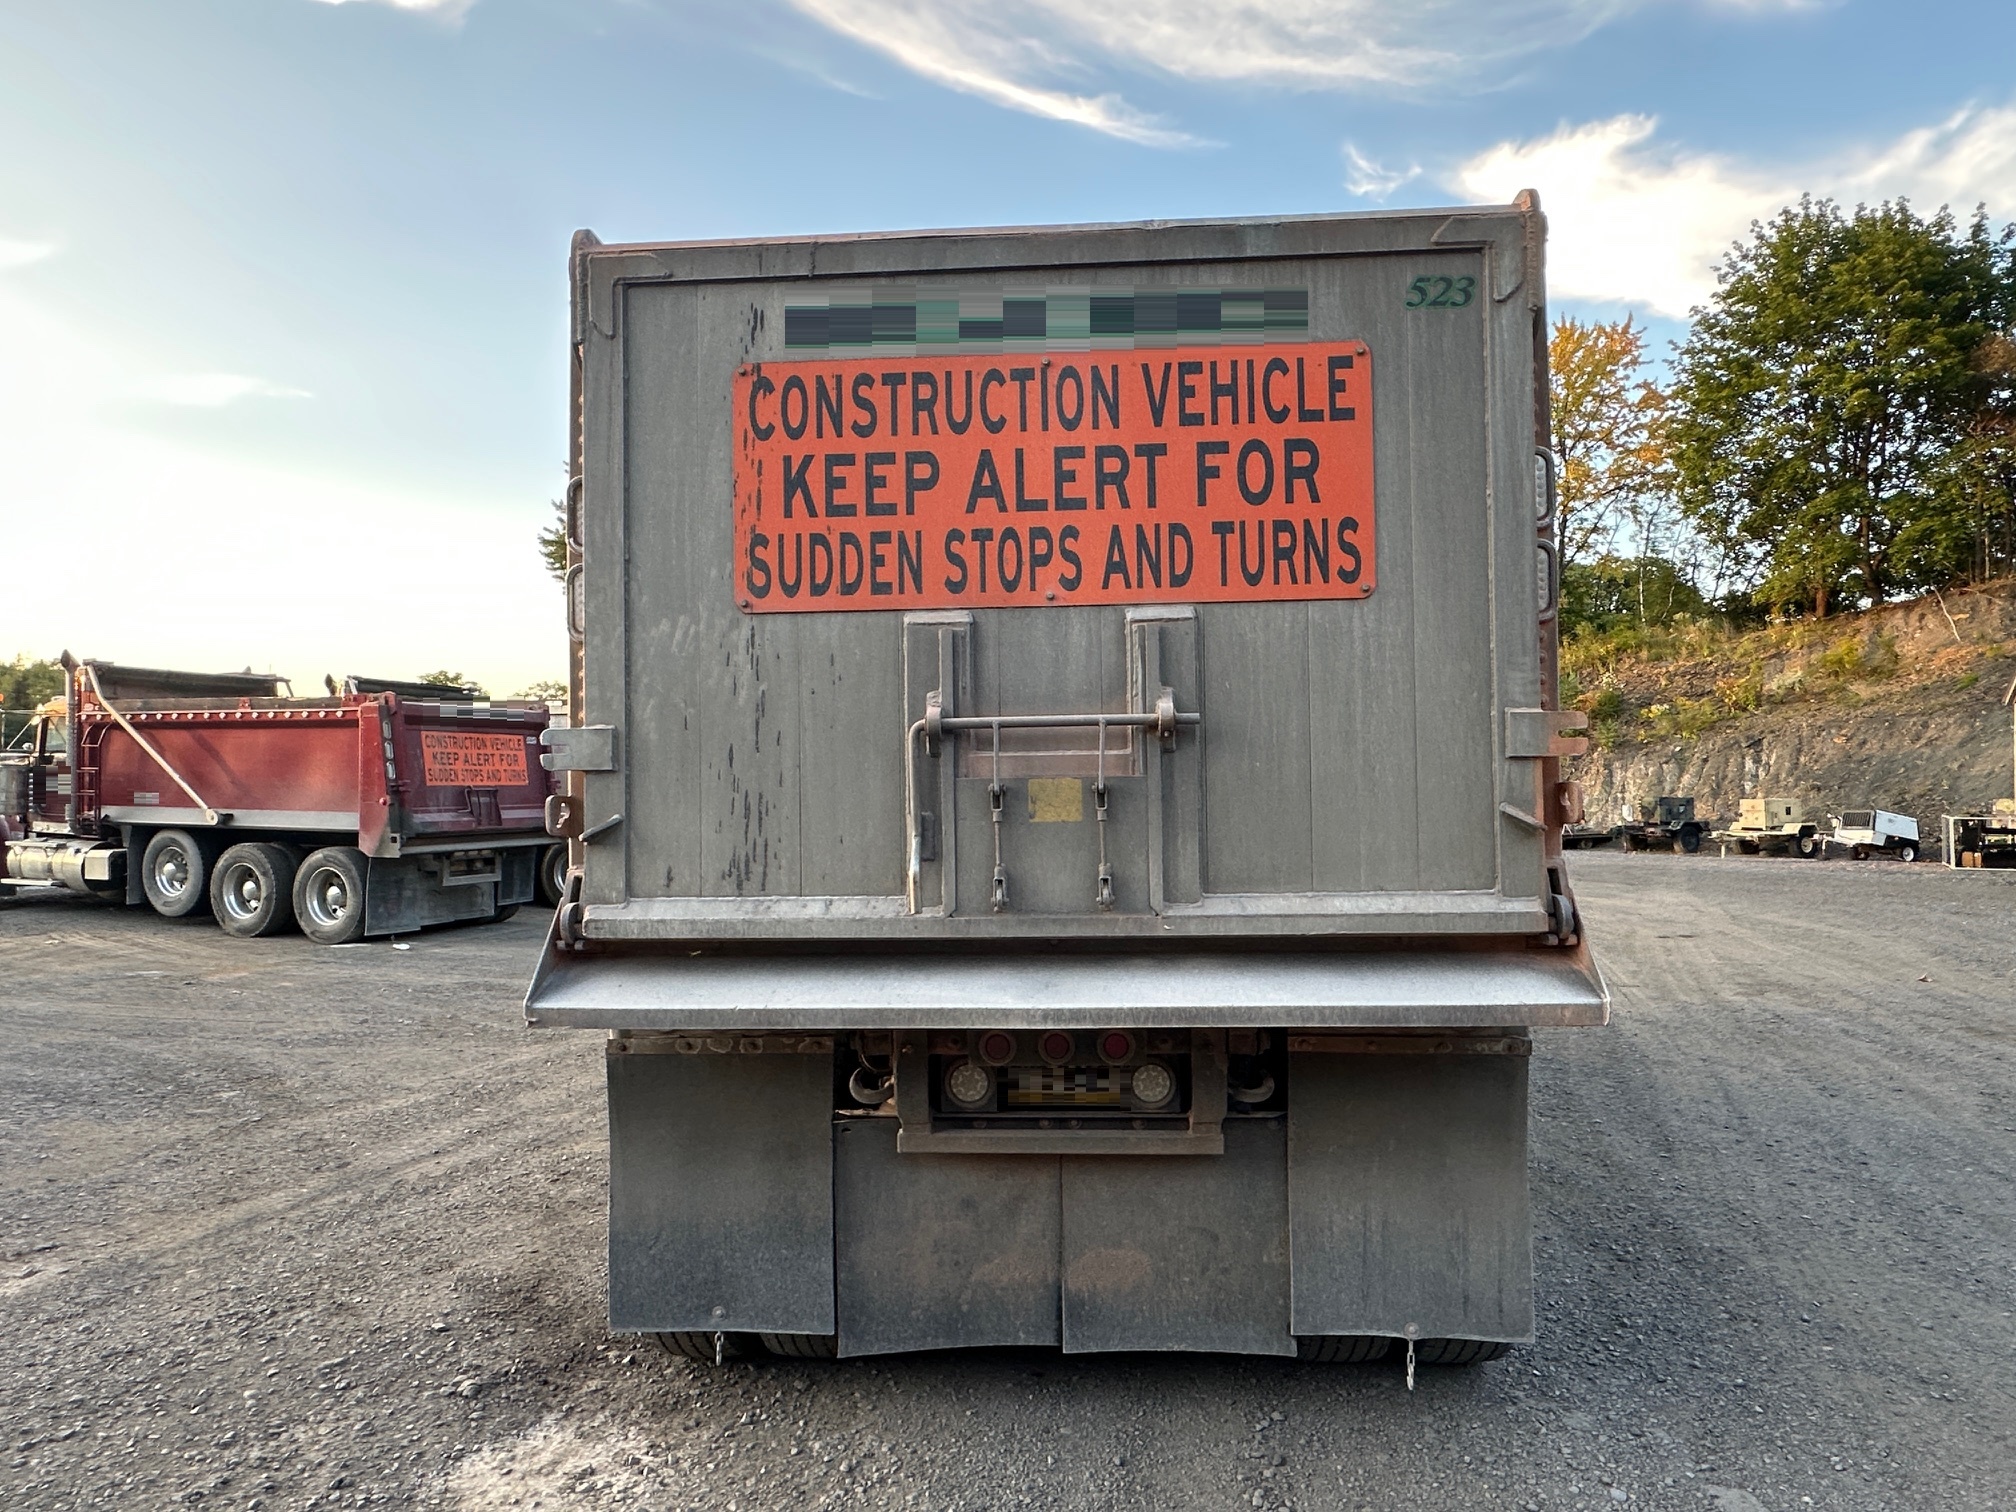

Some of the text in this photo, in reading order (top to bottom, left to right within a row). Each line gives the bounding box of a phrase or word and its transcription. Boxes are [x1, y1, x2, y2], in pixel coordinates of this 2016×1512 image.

[1405, 274, 1479, 310] 523
[750, 354, 1356, 442] CONSTRUCTION VEHICLE
[782, 437, 1321, 519] KEEP ALERT FOR
[746, 516, 1362, 599] SUDDEN STOPS AND TURNS
[424, 734, 488, 751] CONSTRUCTION
[489, 738, 523, 751] VEHICLE
[432, 751, 519, 767] KEEP ALERT FOR
[427, 768, 527, 782] SUDDEN STOPS AND TURNS
